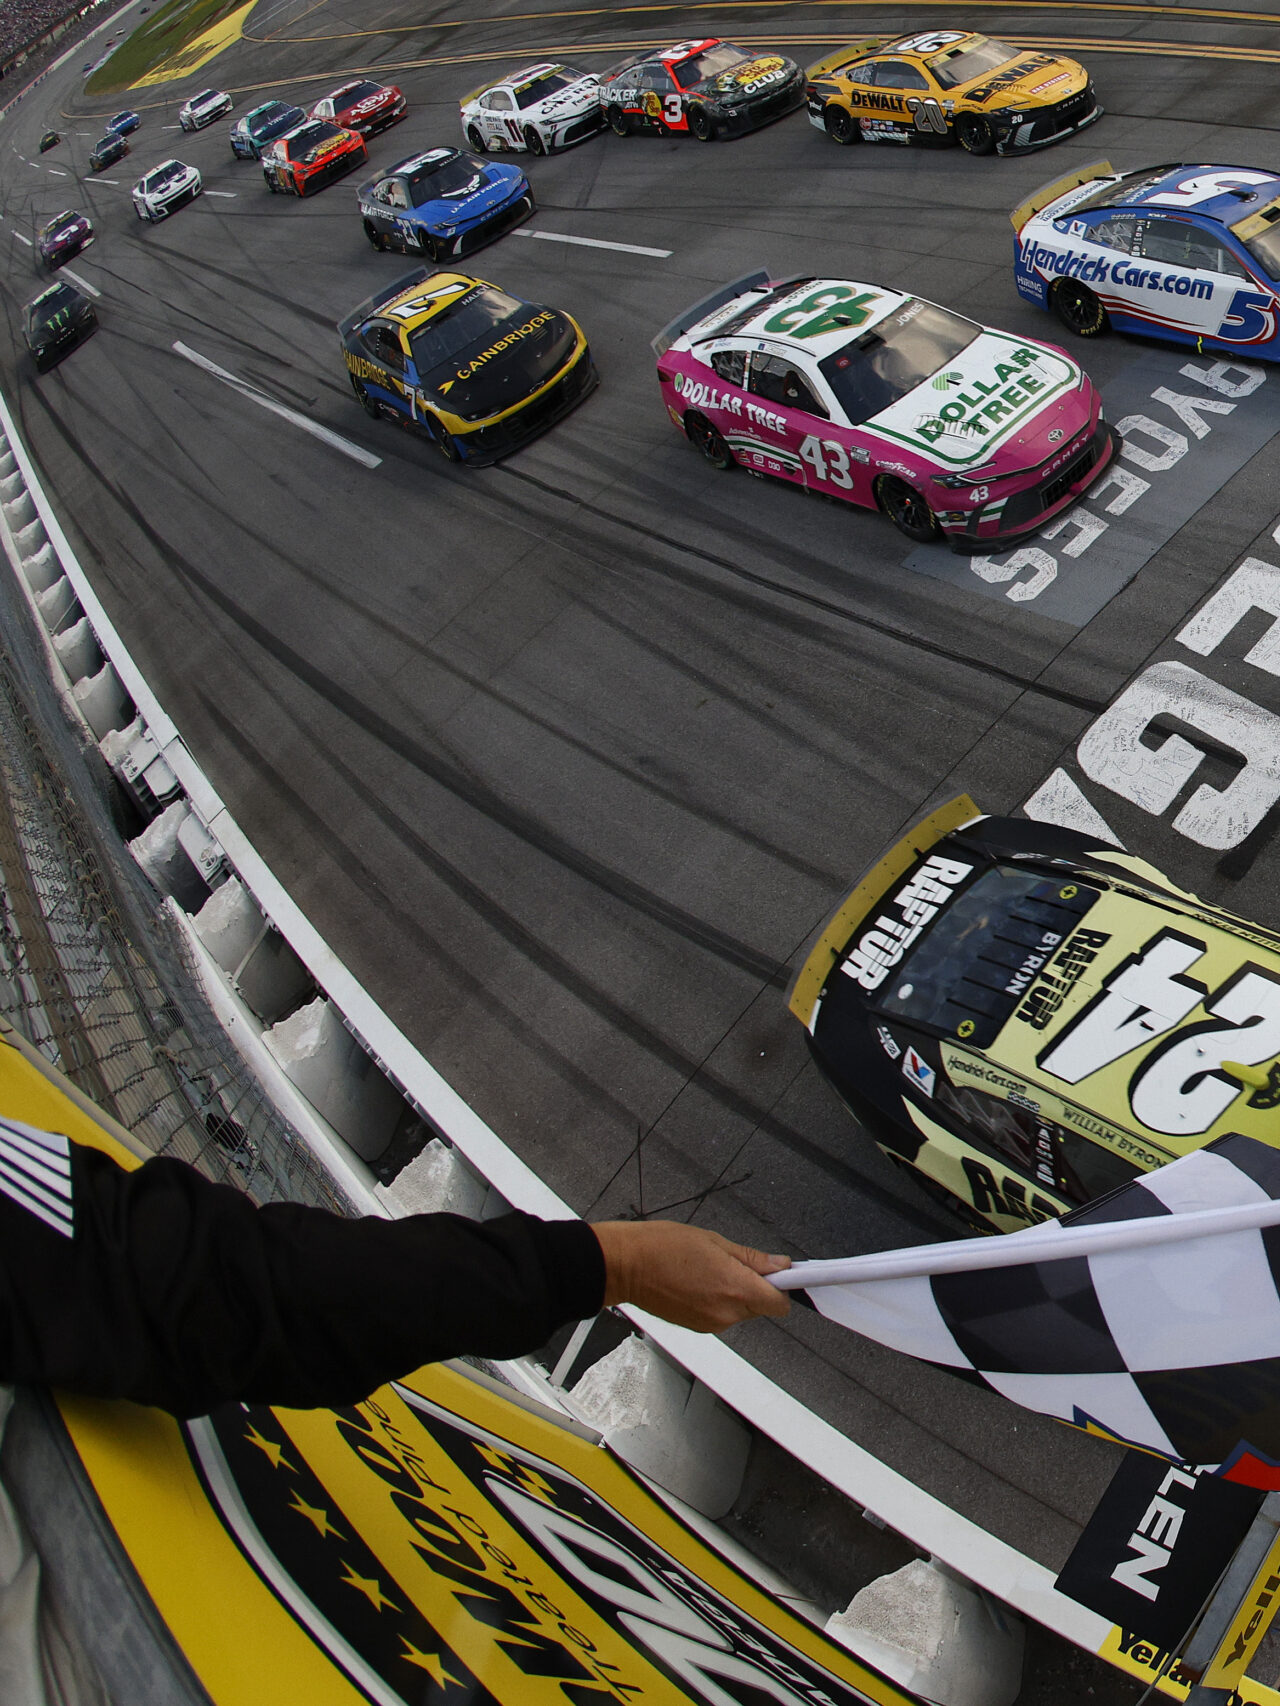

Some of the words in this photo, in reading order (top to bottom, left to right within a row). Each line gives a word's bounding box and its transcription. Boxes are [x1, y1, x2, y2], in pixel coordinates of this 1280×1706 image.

[600, 89, 637, 102] TRACKER
[743, 71, 786, 94] CLUB
[503, 118, 524, 143] 11
[664, 94, 682, 123] 3
[906, 96, 948, 134] 20
[1011, 114, 1023, 124] 20
[466, 191, 482, 205] AIR
[481, 177, 509, 194] FORCE
[1016, 275, 1043, 294] HIRING
[896, 301, 925, 327] JONES
[1216, 289, 1279, 344] 5
[457, 310, 556, 380] GAINBRIDGE
[404, 385, 418, 421] 7
[682, 377, 743, 417] DOLLAR
[745, 403, 788, 436] TREE
[914, 348, 1041, 444] DOLLAR
[961, 373, 1047, 437] TREE
[798, 434, 854, 490] 43
[1041, 433, 1090, 478] CAMRY
[969, 485, 990, 503] 43
[840, 854, 975, 993] RAPTOR
[1004, 930, 1062, 996] BYRON
[1013, 926, 1112, 1032] RAPTOR
[948, 1055, 1028, 1094] HendrickCars.com
[1062, 1107, 1116, 1144] WILLIAM
[1116, 1137, 1168, 1171] BYRON
[1110, 1464, 1200, 1602] LEN
[440, 1503, 645, 1703] Treated
